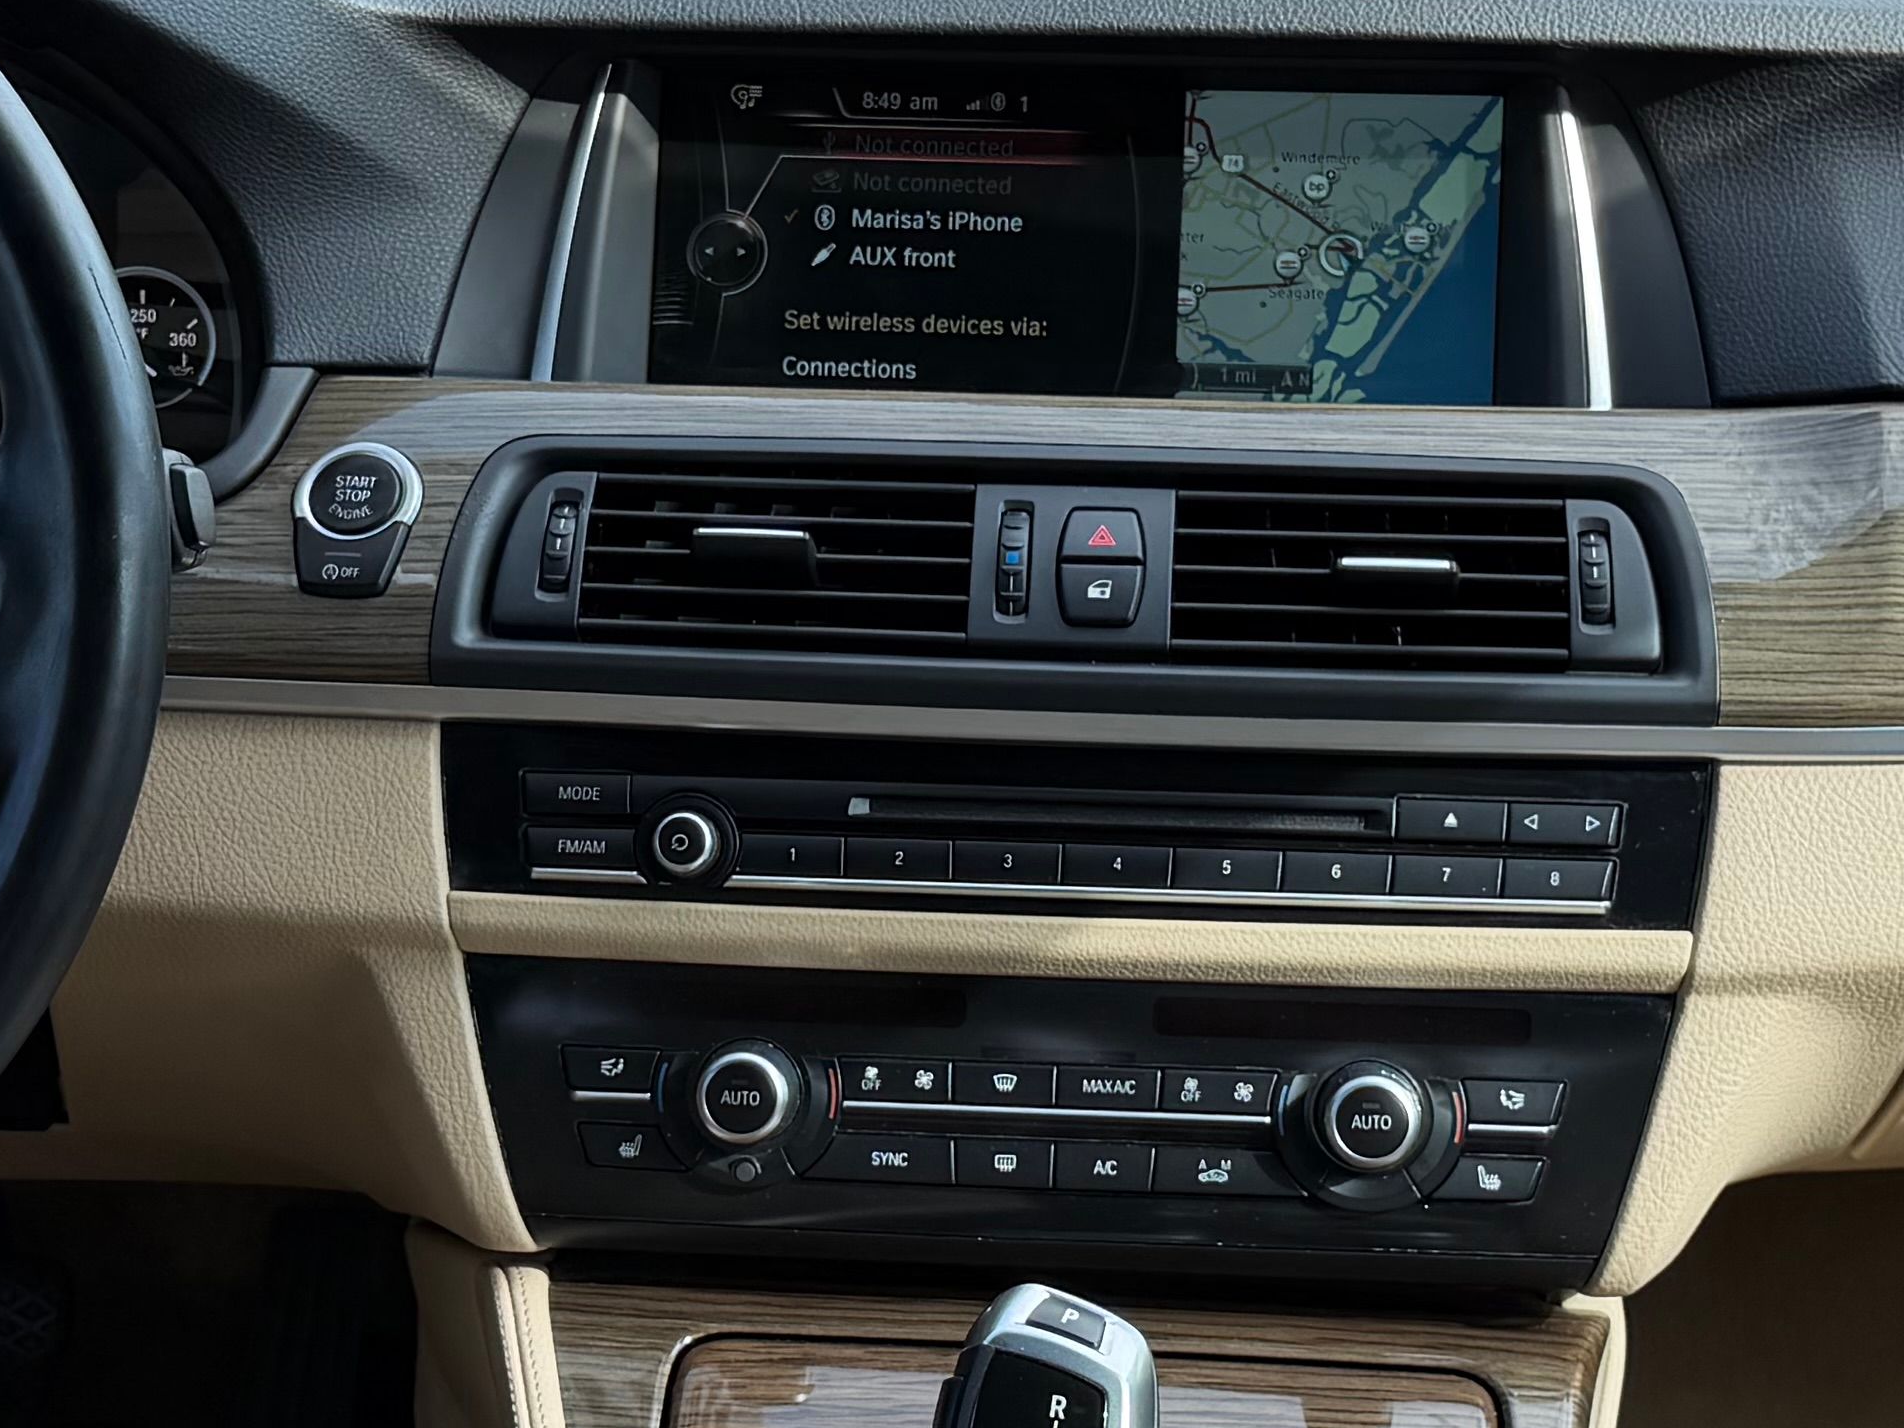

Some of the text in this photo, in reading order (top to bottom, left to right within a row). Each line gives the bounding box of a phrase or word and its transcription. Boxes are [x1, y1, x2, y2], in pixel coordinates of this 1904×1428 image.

[862, 91, 901, 110] 8:49
[910, 95, 938, 111] am
[855, 134, 1015, 158] Not connected
[853, 172, 1013, 195] Not connected
[948, 210, 1023, 233] iPhone
[850, 246, 956, 268] AUX front
[131, 308, 157, 323] 250
[784, 310, 1048, 338] Set wireless devices via:
[168, 332, 197, 347] 360
[782, 357, 917, 381] Connections
[1235, 367, 1257, 385] mi
[335, 475, 378, 489] START
[335, 489, 371, 502] STOP
[328, 503, 374, 520] ENGINE
[340, 566, 361, 579] OFF
[558, 784, 602, 803] MODE
[557, 837, 607, 856] FM/AM
[789, 846, 797, 862] 1
[894, 850, 905, 866] 2
[1002, 852, 1014, 869] 3
[1112, 856, 1123, 872] 4
[1222, 859, 1232, 875] 5
[1331, 863, 1342, 880] 6
[1441, 866, 1452, 883] 7
[1549, 870, 1561, 887] 8
[860, 1078, 883, 1092] OFF
[720, 1089, 761, 1109] AUTO
[1180, 1090, 1203, 1103] OFF
[1350, 1113, 1393, 1133] AUTO
[871, 1150, 909, 1169] SYNC
[1093, 1159, 1118, 1176] A/C
[1198, 1158, 1232, 1171] A M
[1061, 1307, 1080, 1324] P
[1049, 1393, 1068, 1421] R
